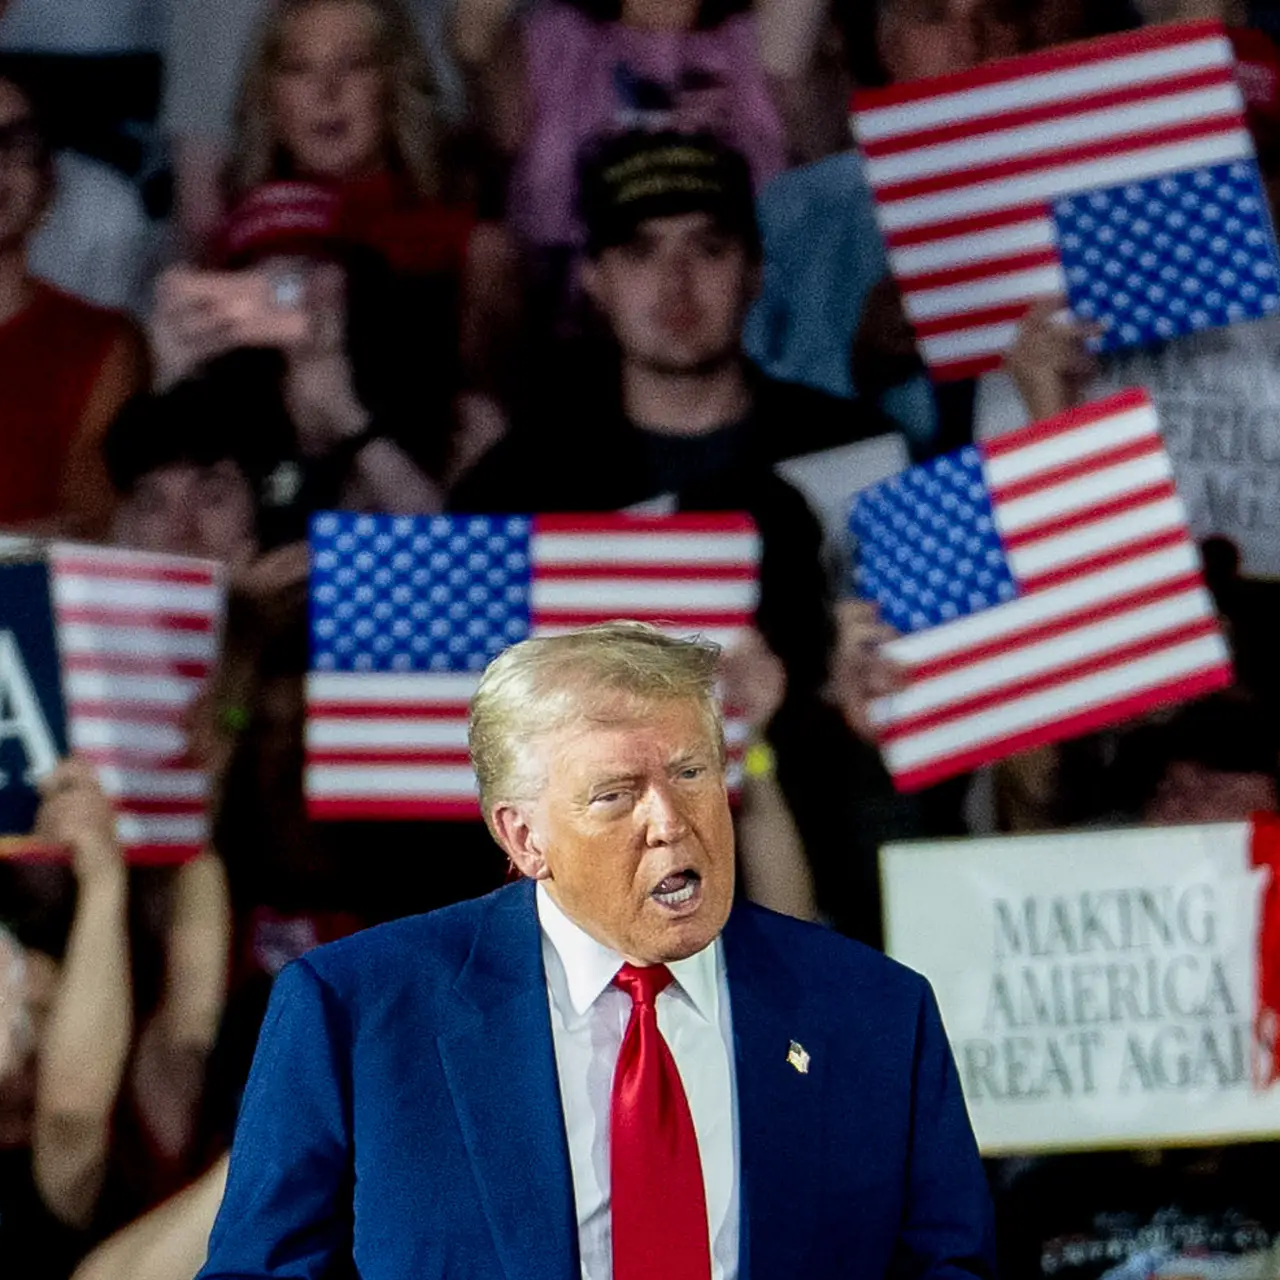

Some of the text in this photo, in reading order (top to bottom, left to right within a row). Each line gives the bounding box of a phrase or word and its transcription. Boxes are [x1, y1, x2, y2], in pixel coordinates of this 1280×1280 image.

[992, 882, 1217, 959] MAKING
[984, 954, 1237, 1032] AMERICA
[960, 1022, 1255, 1104] REAT AGAI
